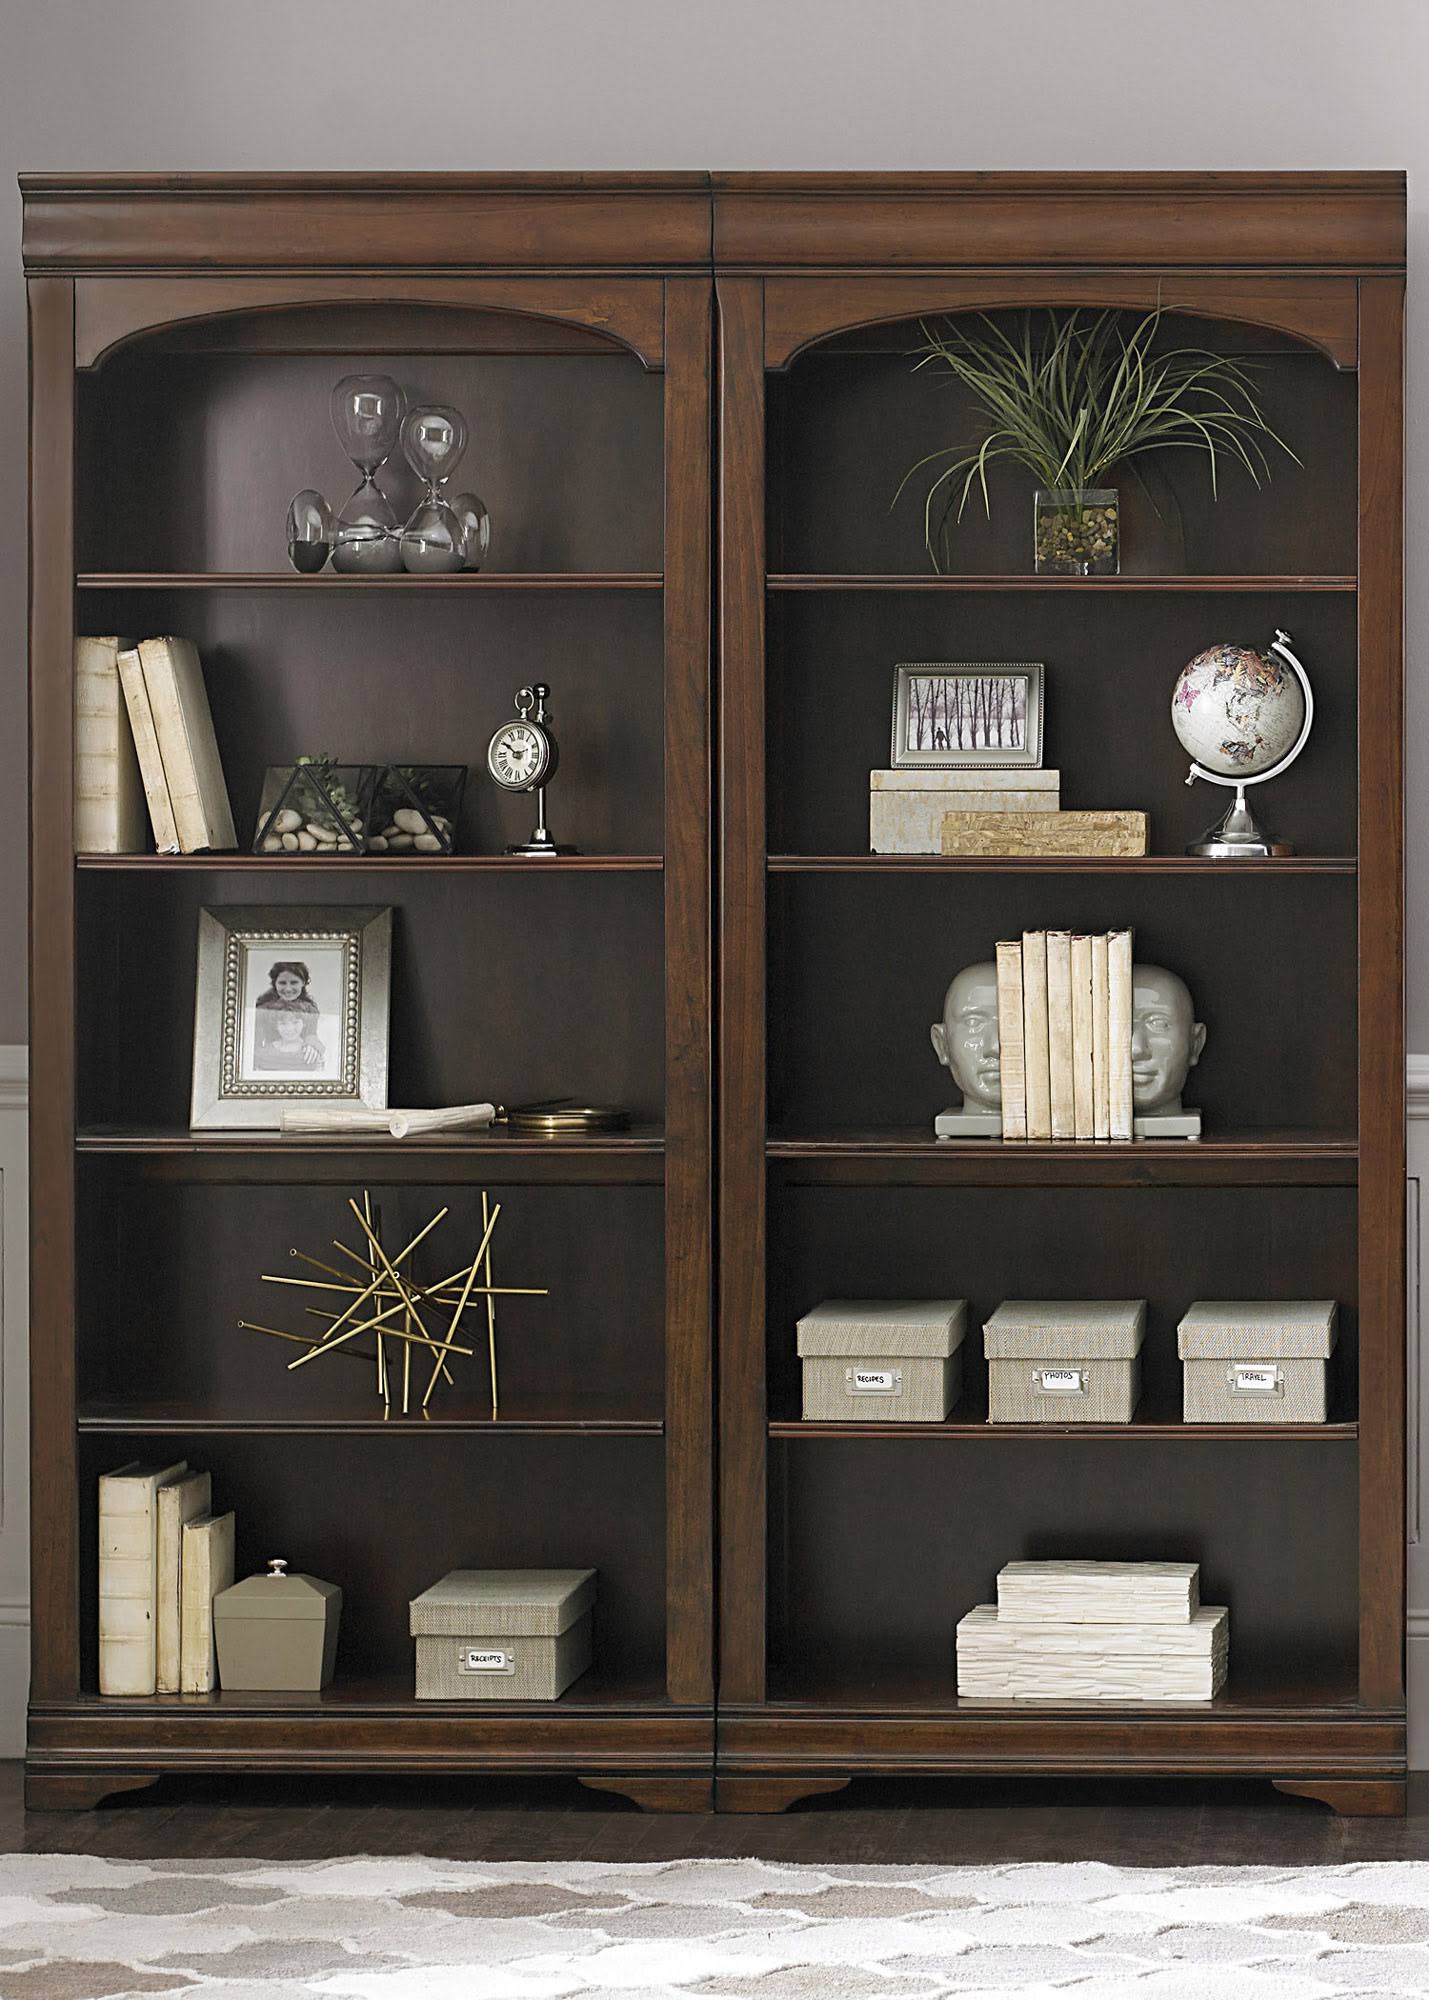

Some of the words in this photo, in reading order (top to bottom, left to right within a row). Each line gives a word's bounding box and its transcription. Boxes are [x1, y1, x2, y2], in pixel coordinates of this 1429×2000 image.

[857, 1375, 884, 1384] RECIPES
[1044, 1372, 1073, 1380] PHOTOS
[1241, 1372, 1267, 1381] TRAVEL
[470, 1655, 501, 1663] RECEIPTS
